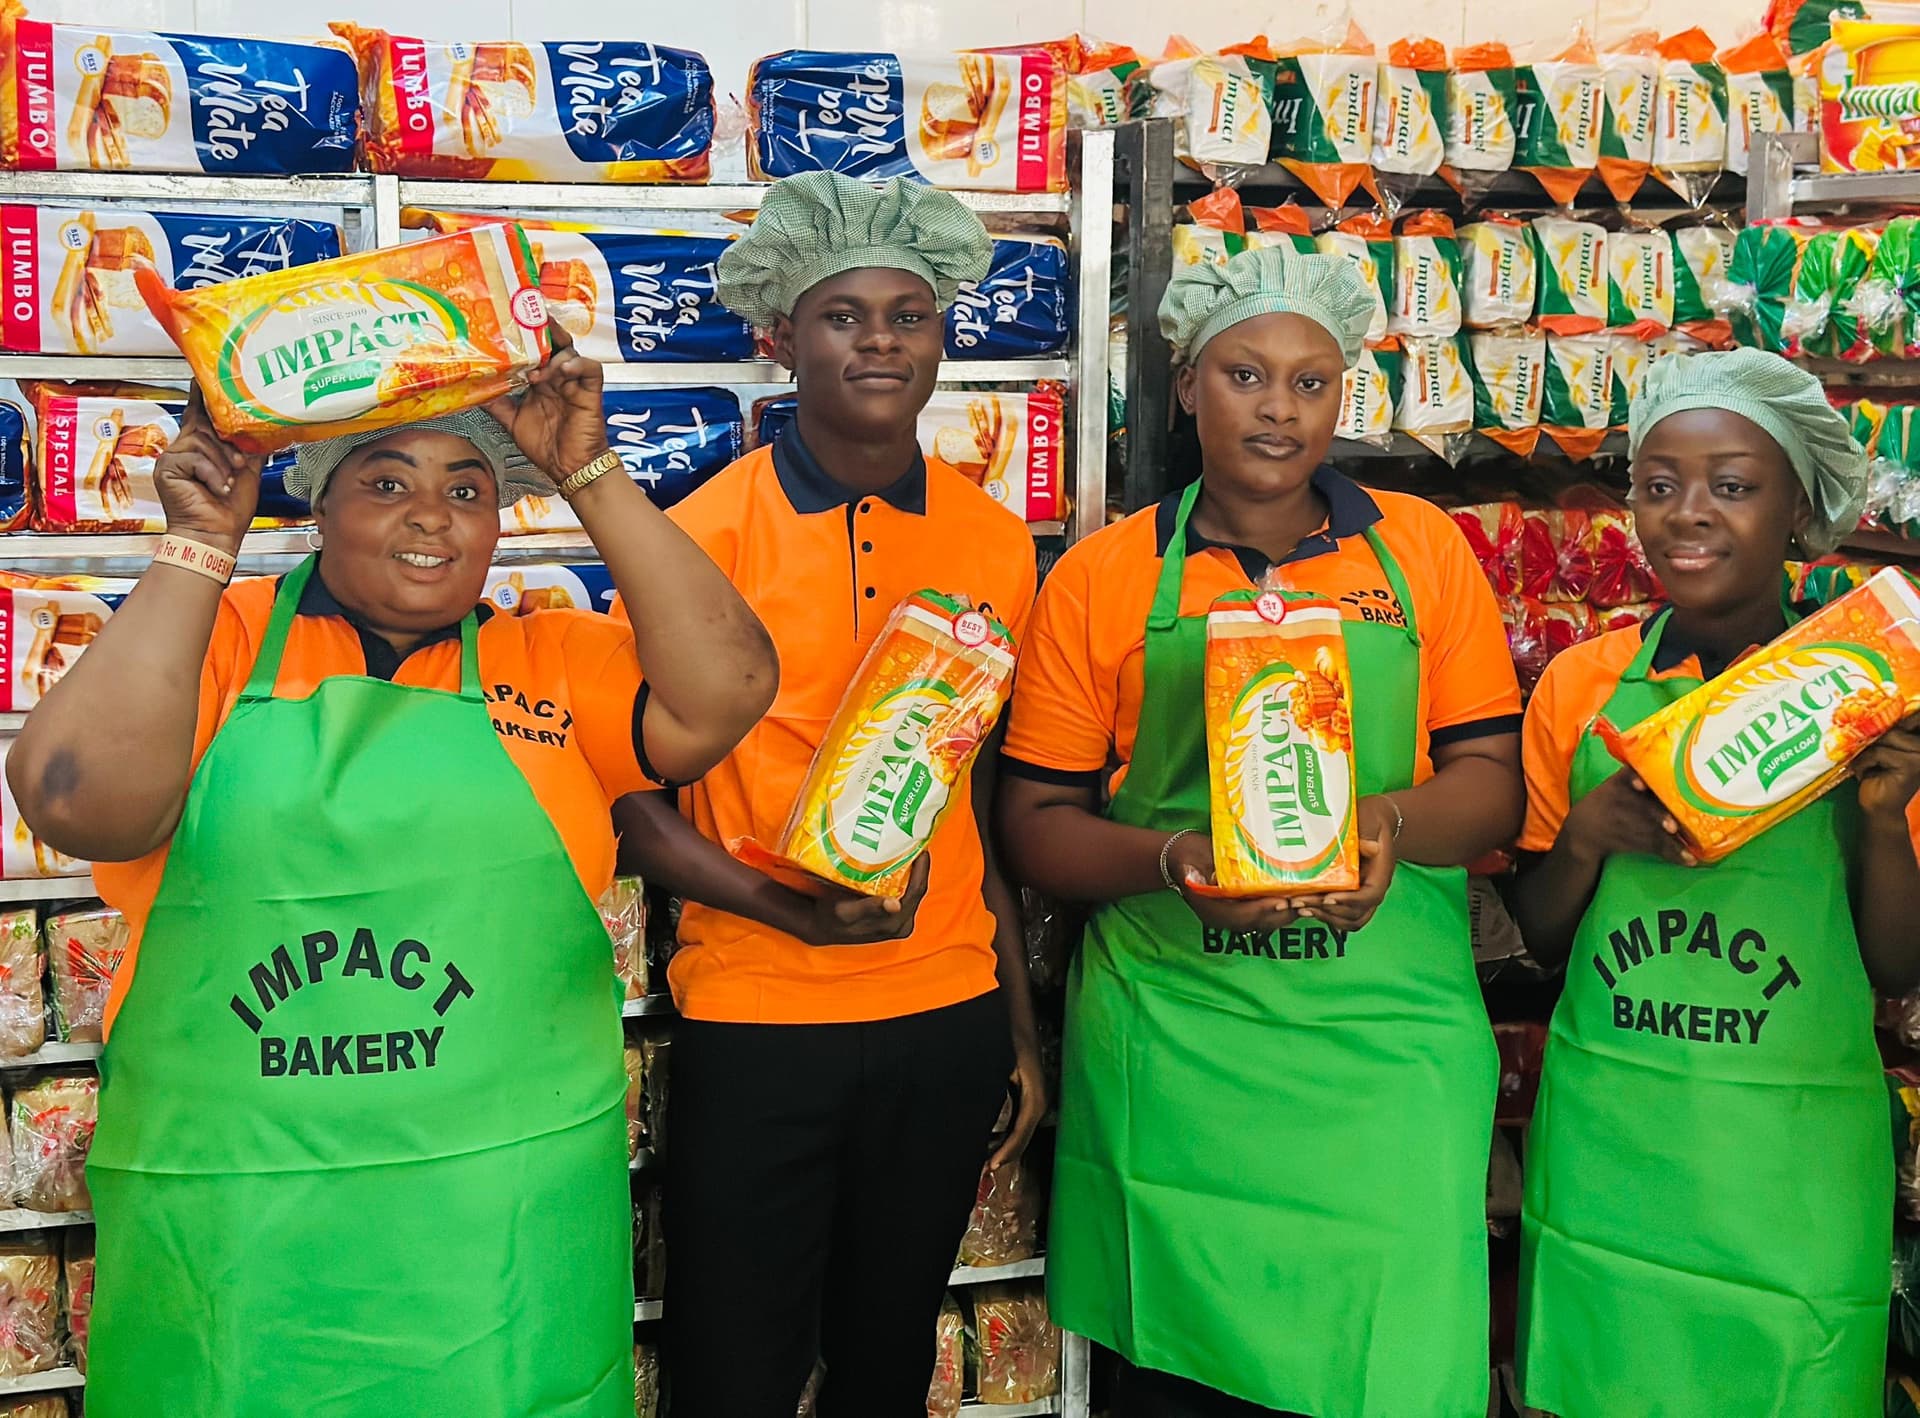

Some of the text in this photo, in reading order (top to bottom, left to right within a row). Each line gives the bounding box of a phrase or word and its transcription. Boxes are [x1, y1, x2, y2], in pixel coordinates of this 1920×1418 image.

[86, 53, 97, 72] BEST
[396, 42, 428, 131] JUMBO
[558, 42, 615, 136] Mate
[610, 43, 667, 113] Tea
[22, 49, 49, 149] JUMBO
[198, 63, 257, 160] Mate
[255, 68, 311, 131] Tea
[795, 90, 846, 154] Tea
[845, 64, 896, 157] Mate
[1022, 74, 1043, 163] JUMBO
[1103, 87, 1118, 124] Imp
[1222, 73, 1242, 143] Impact
[1343, 73, 1360, 144] Impact
[1396, 85, 1413, 156] Impact
[1575, 80, 1591, 149] Impact
[1632, 74, 1651, 142] Impact
[1676, 79, 1693, 146] Impact
[1840, 73, 1920, 127] Impa
[70, 228, 82, 247] BEST
[237, 234, 293, 278] Te
[1577, 232, 1593, 297] Impact
[7, 226, 33, 321] JUMBO
[672, 262, 719, 325] Tea
[991, 266, 1033, 323] Tea
[1414, 255, 1431, 324] Impact
[1641, 245, 1655, 310] Impact
[313, 312, 344, 325] SINCE
[527, 295, 541, 319] BEST
[621, 262, 674, 352] Mate
[255, 311, 429, 387] IMPACT
[1427, 343, 1443, 408] Impact
[1589, 349, 1604, 411] Impact
[310, 375, 347, 393] SUPER
[1352, 368, 1370, 433] Impact
[1511, 355, 1528, 421] Impact
[54, 415, 70, 497] SPECIAL
[607, 408, 662, 493] Mat
[657, 407, 708, 470] Tea
[1031, 414, 1052, 498] JUMBO
[164, 541, 177, 557] For
[181, 546, 197, 562] Me
[962, 620, 983, 633] BEST
[483, 684, 573, 730] PACT
[492, 718, 566, 748] AKERY
[1704, 664, 1855, 787] IMPACT
[851, 702, 934, 852] IMPACT
[1261, 694, 1307, 848] IMPACT
[1304, 749, 1319, 808] SUPER LOAF
[1763, 733, 1818, 776] SUPER LOAF
[899, 769, 928, 824] SUPER LOAF
[1203, 926, 1348, 960] BAKERY
[1592, 909, 1801, 1001] IMPACT
[229, 927, 475, 1035] IMPACT
[260, 1026, 444, 1078] BAKERY
[1612, 993, 1769, 1046] BAKERY
